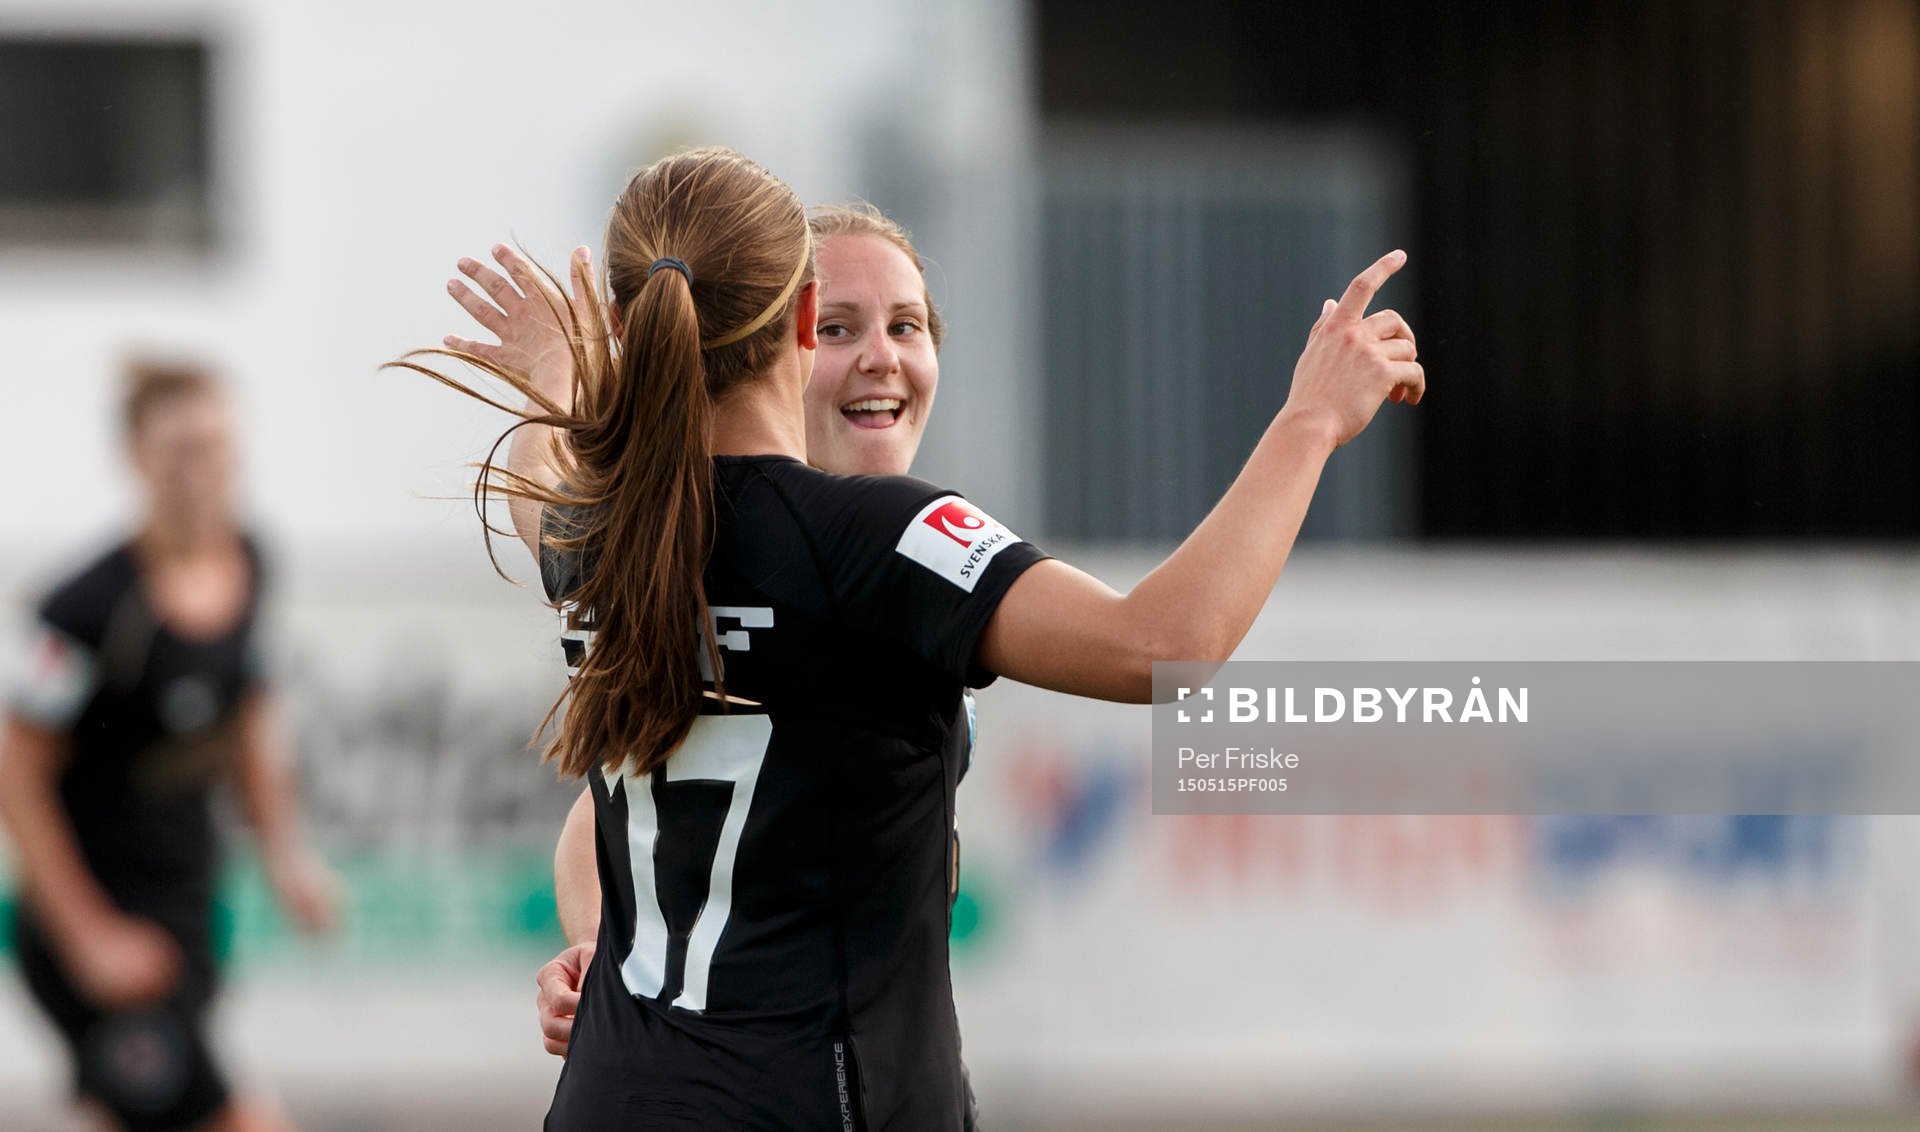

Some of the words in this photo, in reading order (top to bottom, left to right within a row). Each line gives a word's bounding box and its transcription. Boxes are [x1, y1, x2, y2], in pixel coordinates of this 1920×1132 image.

[960, 533, 1005, 578] SVENSKA
[600, 714, 774, 1011] 17
[834, 1042, 853, 1132] EXPERIENCE
